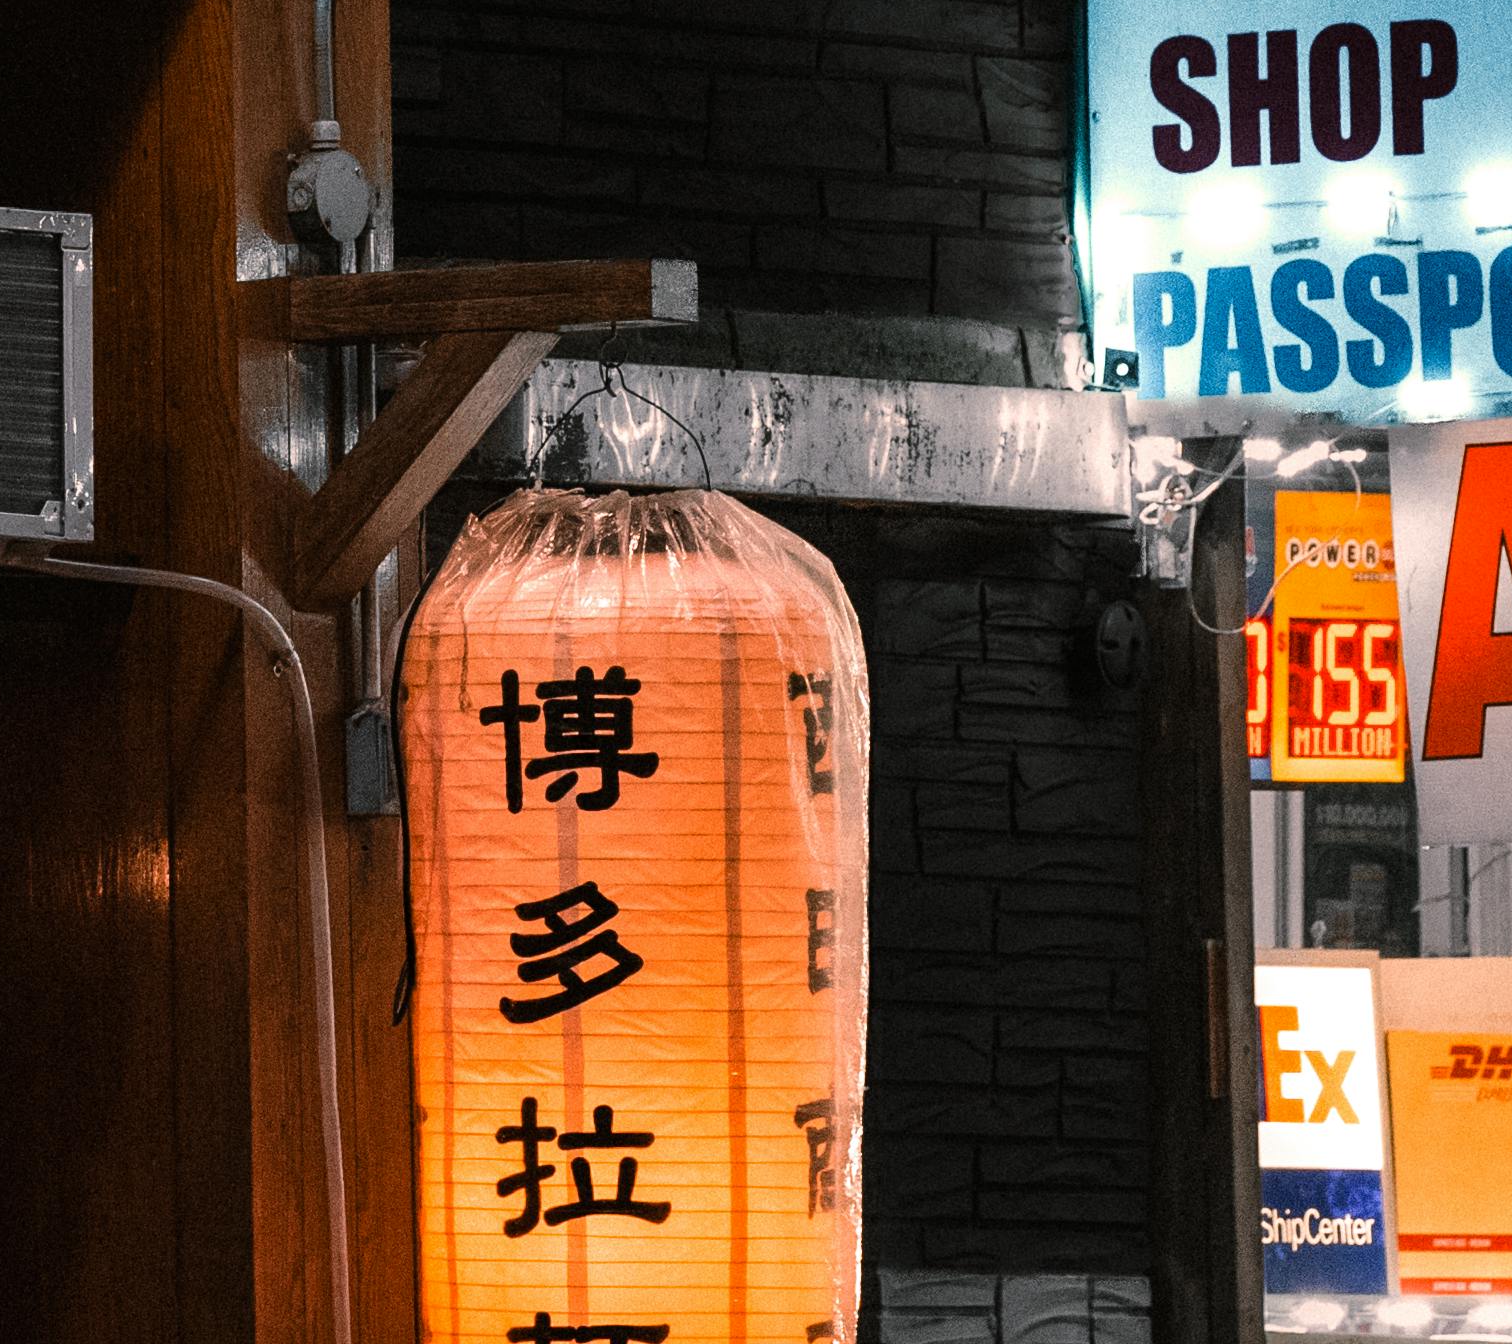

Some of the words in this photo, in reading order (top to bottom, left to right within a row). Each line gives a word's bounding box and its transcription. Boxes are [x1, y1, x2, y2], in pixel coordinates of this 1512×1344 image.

[1149, 18, 1459, 174] SHOP
[1289, 543, 1376, 563] POWER
[1293, 727, 1393, 757] MILLION
[1261, 1208, 1375, 1252] ShipCenter
